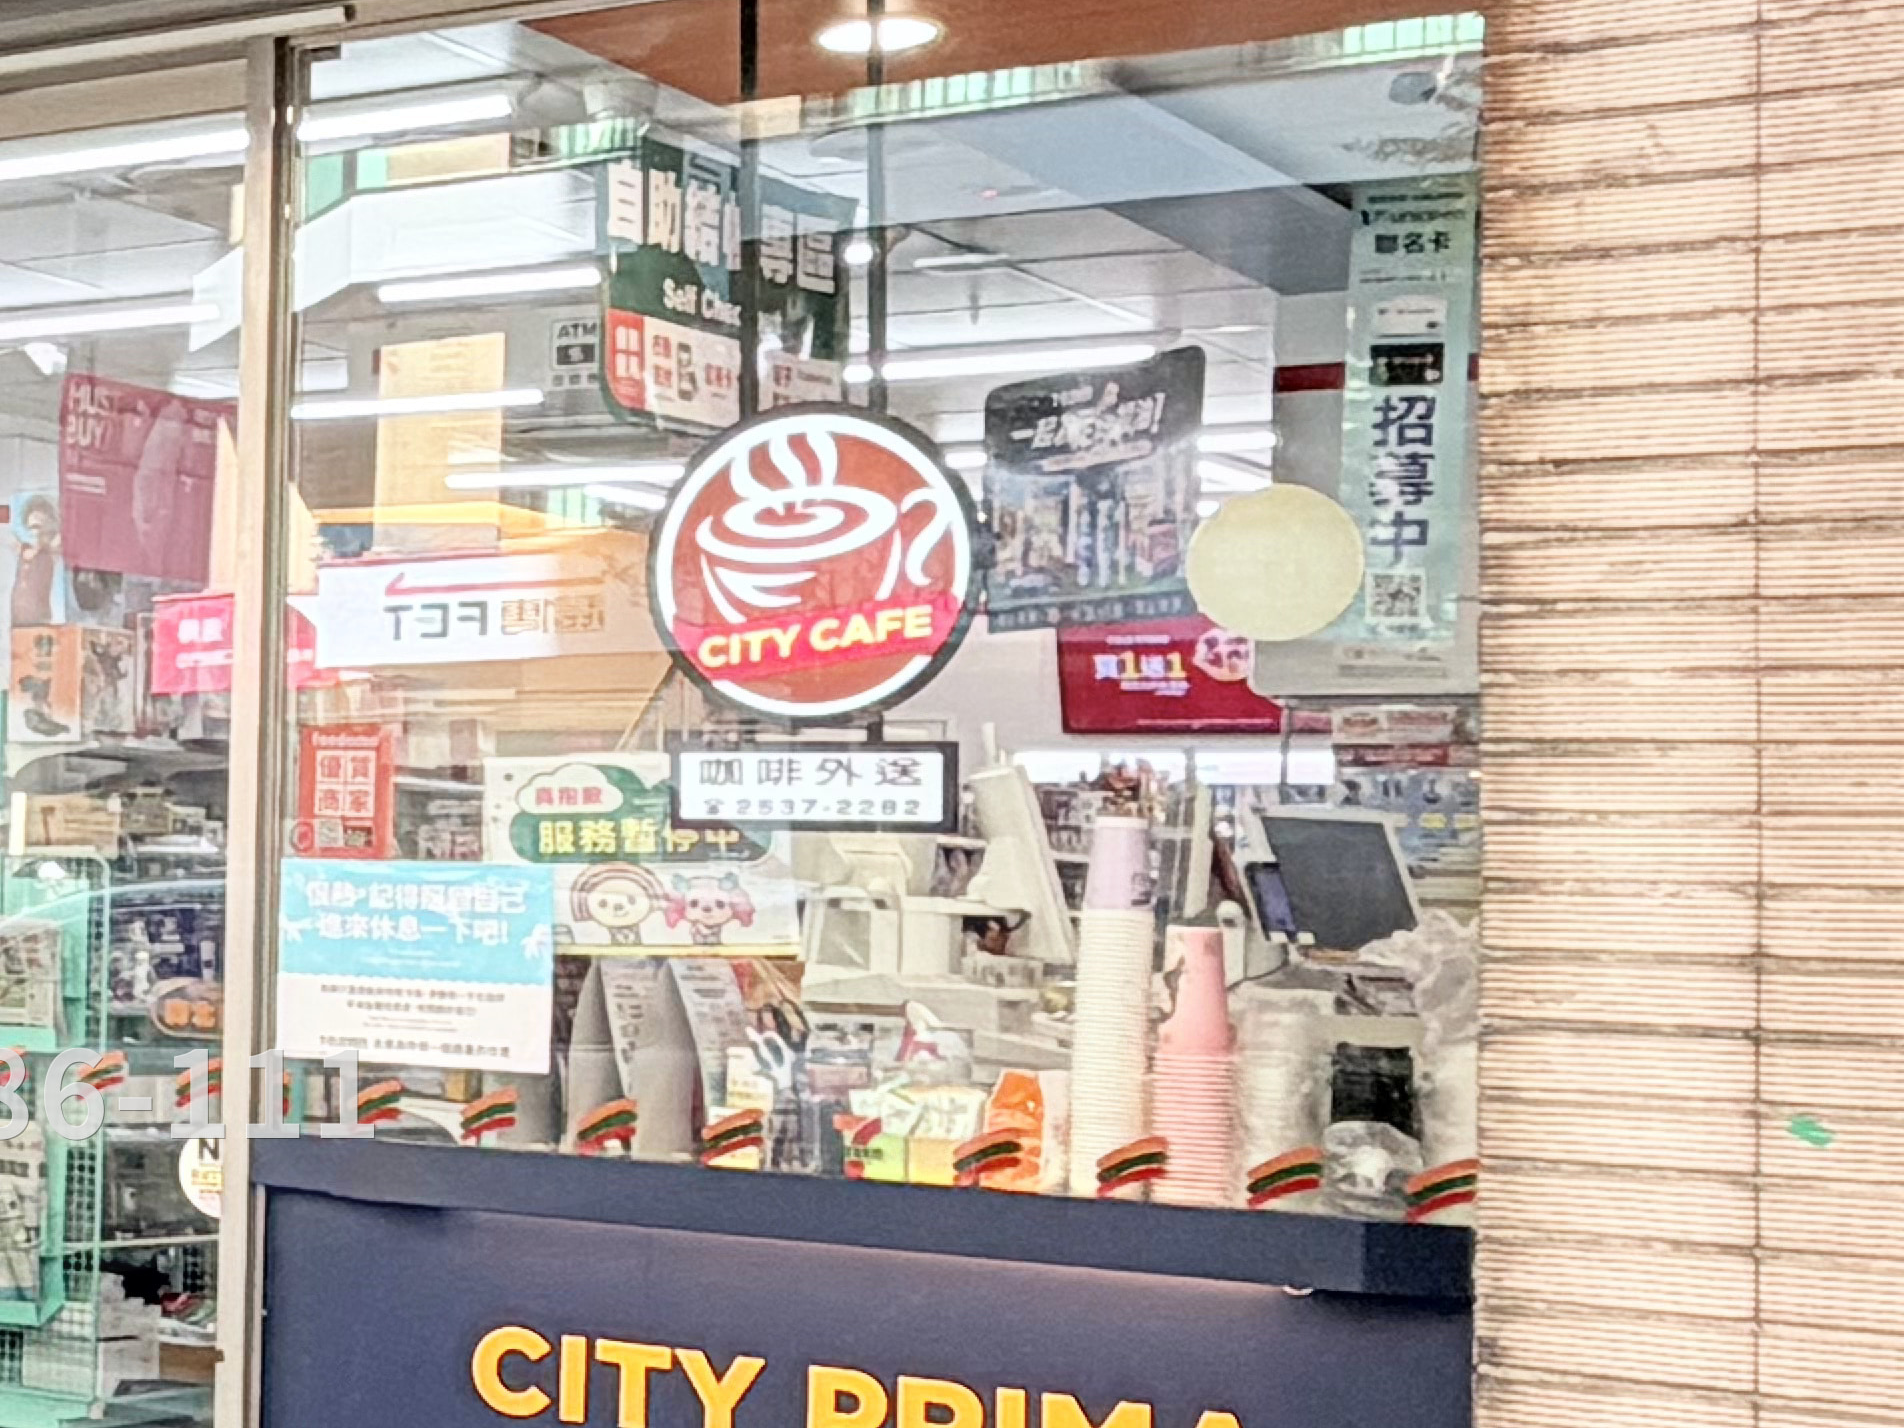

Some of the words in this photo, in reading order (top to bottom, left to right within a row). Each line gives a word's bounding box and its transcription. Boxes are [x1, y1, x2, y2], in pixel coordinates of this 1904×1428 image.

[663, 278, 697, 313] Self
[558, 322, 597, 339] ATM
[1367, 395, 1437, 564] 招募中
[698, 623, 801, 672] CITY
[808, 603, 935, 652] CAFE
[700, 757, 923, 787] 咖啡外送
[538, 817, 740, 856] 服務暫停中
